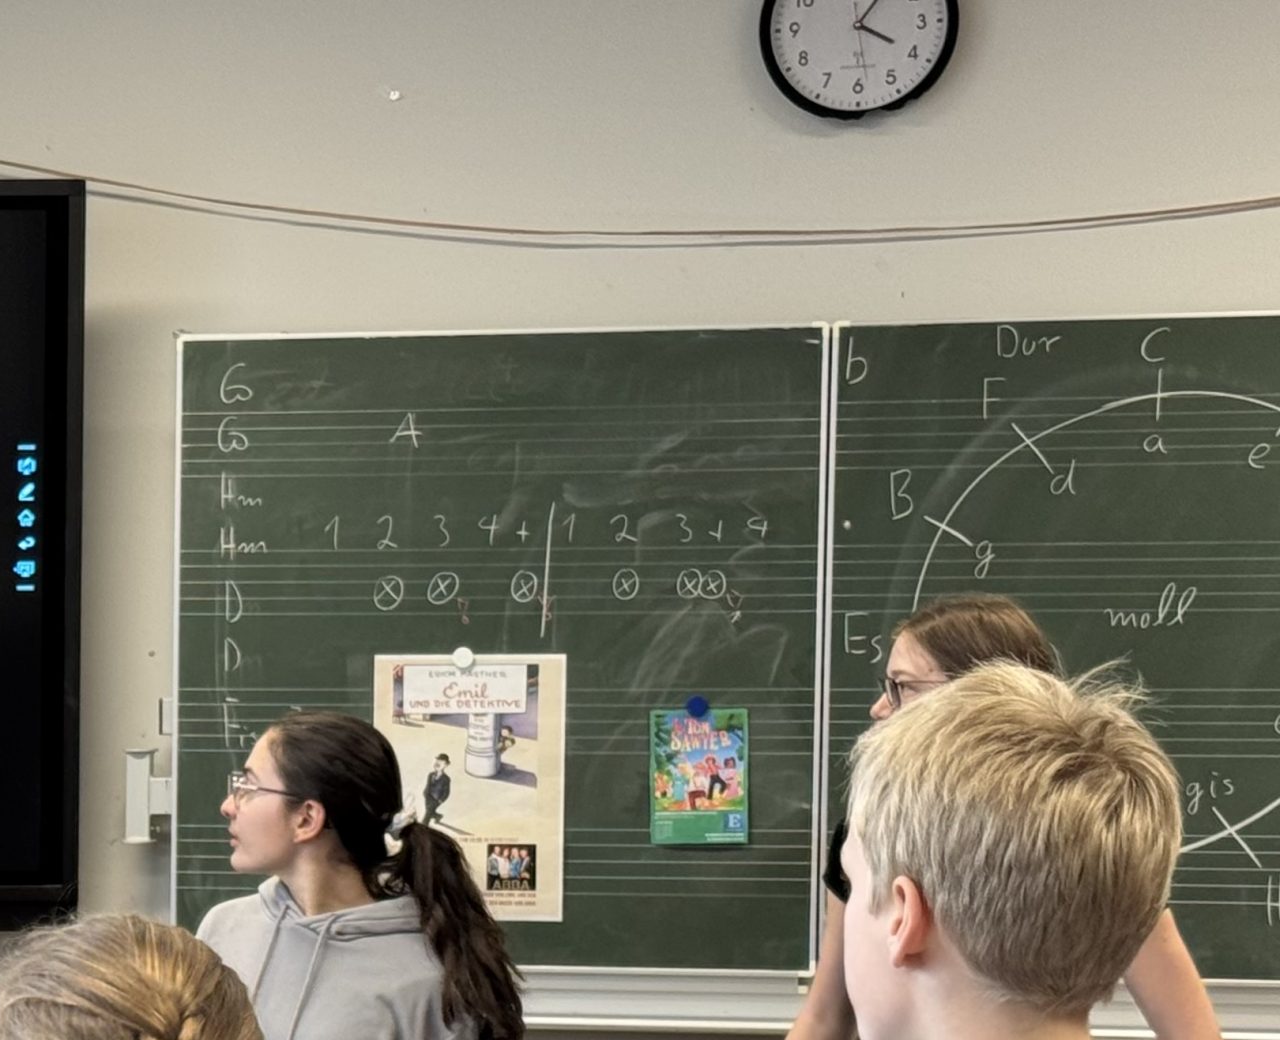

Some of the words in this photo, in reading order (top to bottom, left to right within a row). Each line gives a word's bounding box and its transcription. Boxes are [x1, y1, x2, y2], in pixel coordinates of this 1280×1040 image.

[788, 21, 801, 38] 9
[915, 13, 928, 30] 3
[797, 50, 809, 67] 8
[907, 44, 919, 60] 4
[822, 72, 832, 89] 7
[851, 77, 864, 94] 6
[885, 69, 897, 85] 5
[995, 324, 1062, 358] Dur
[1140, 327, 1171, 363] C
[845, 336, 868, 384] b
[982, 377, 1007, 420] F
[388, 412, 423, 449] A
[1142, 433, 1168, 454] a
[1248, 443, 1271, 469] e
[1049, 459, 1077, 495] d
[889, 468, 914, 519] B
[324, 514, 340, 551] 1
[376, 514, 399, 551] 2
[433, 514, 451, 547] 3
[477, 513, 500, 546] 4
[562, 512, 576, 542] 1
[609, 513, 639, 542] 2
[675, 513, 693, 542] 3
[973, 540, 996, 579] g
[1103, 581, 1197, 629] moll
[844, 611, 883, 664] Es
[409, 700, 431, 709] UND
[434, 699, 451, 709] DIE
[456, 698, 521, 709] DETEKTIVE
[442, 681, 489, 700] Emil
[670, 730, 732, 752] SAWYER
[1185, 770, 1235, 815] gis
[728, 813, 741, 828] E
